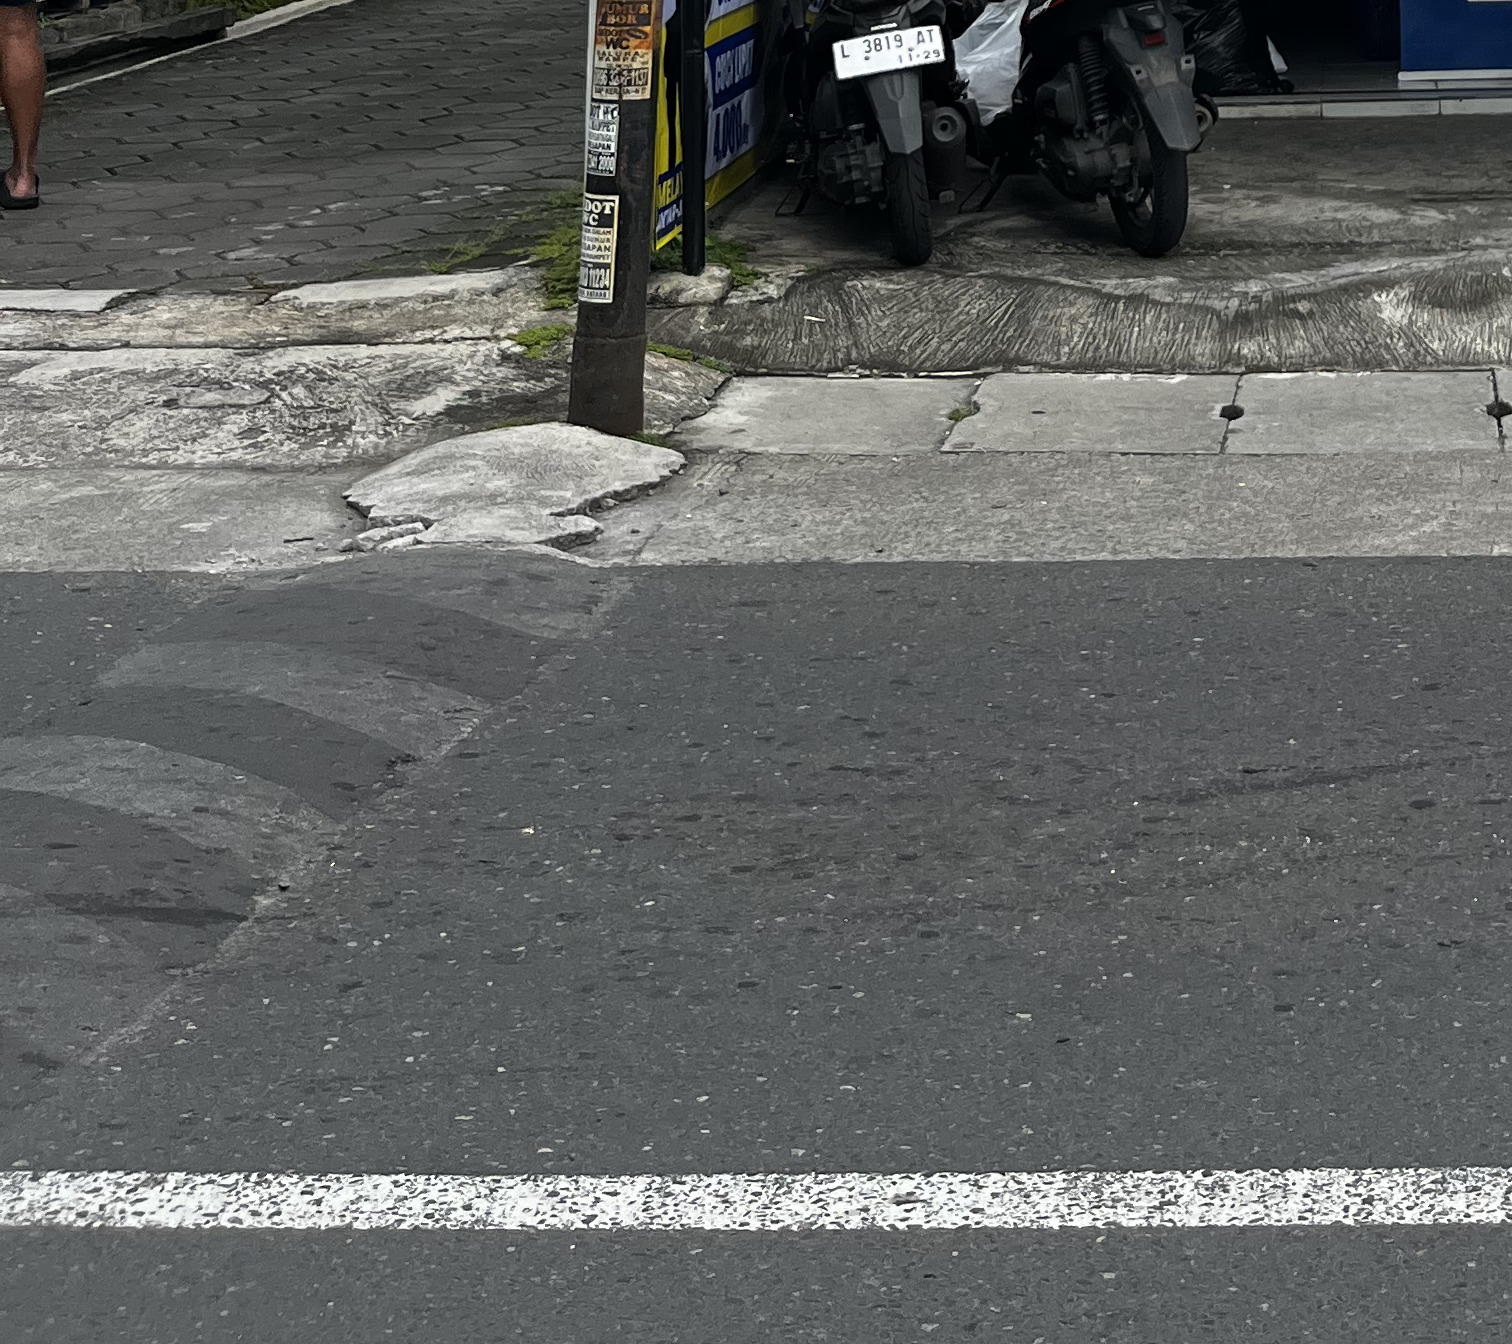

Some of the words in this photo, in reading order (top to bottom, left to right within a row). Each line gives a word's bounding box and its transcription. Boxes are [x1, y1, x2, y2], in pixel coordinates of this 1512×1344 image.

[601, 3, 649, 15] UMUR
[605, 37, 631, 50] WC
[840, 43, 851, 59] L
[862, 33, 904, 54] 3819
[916, 28, 935, 46] AT
